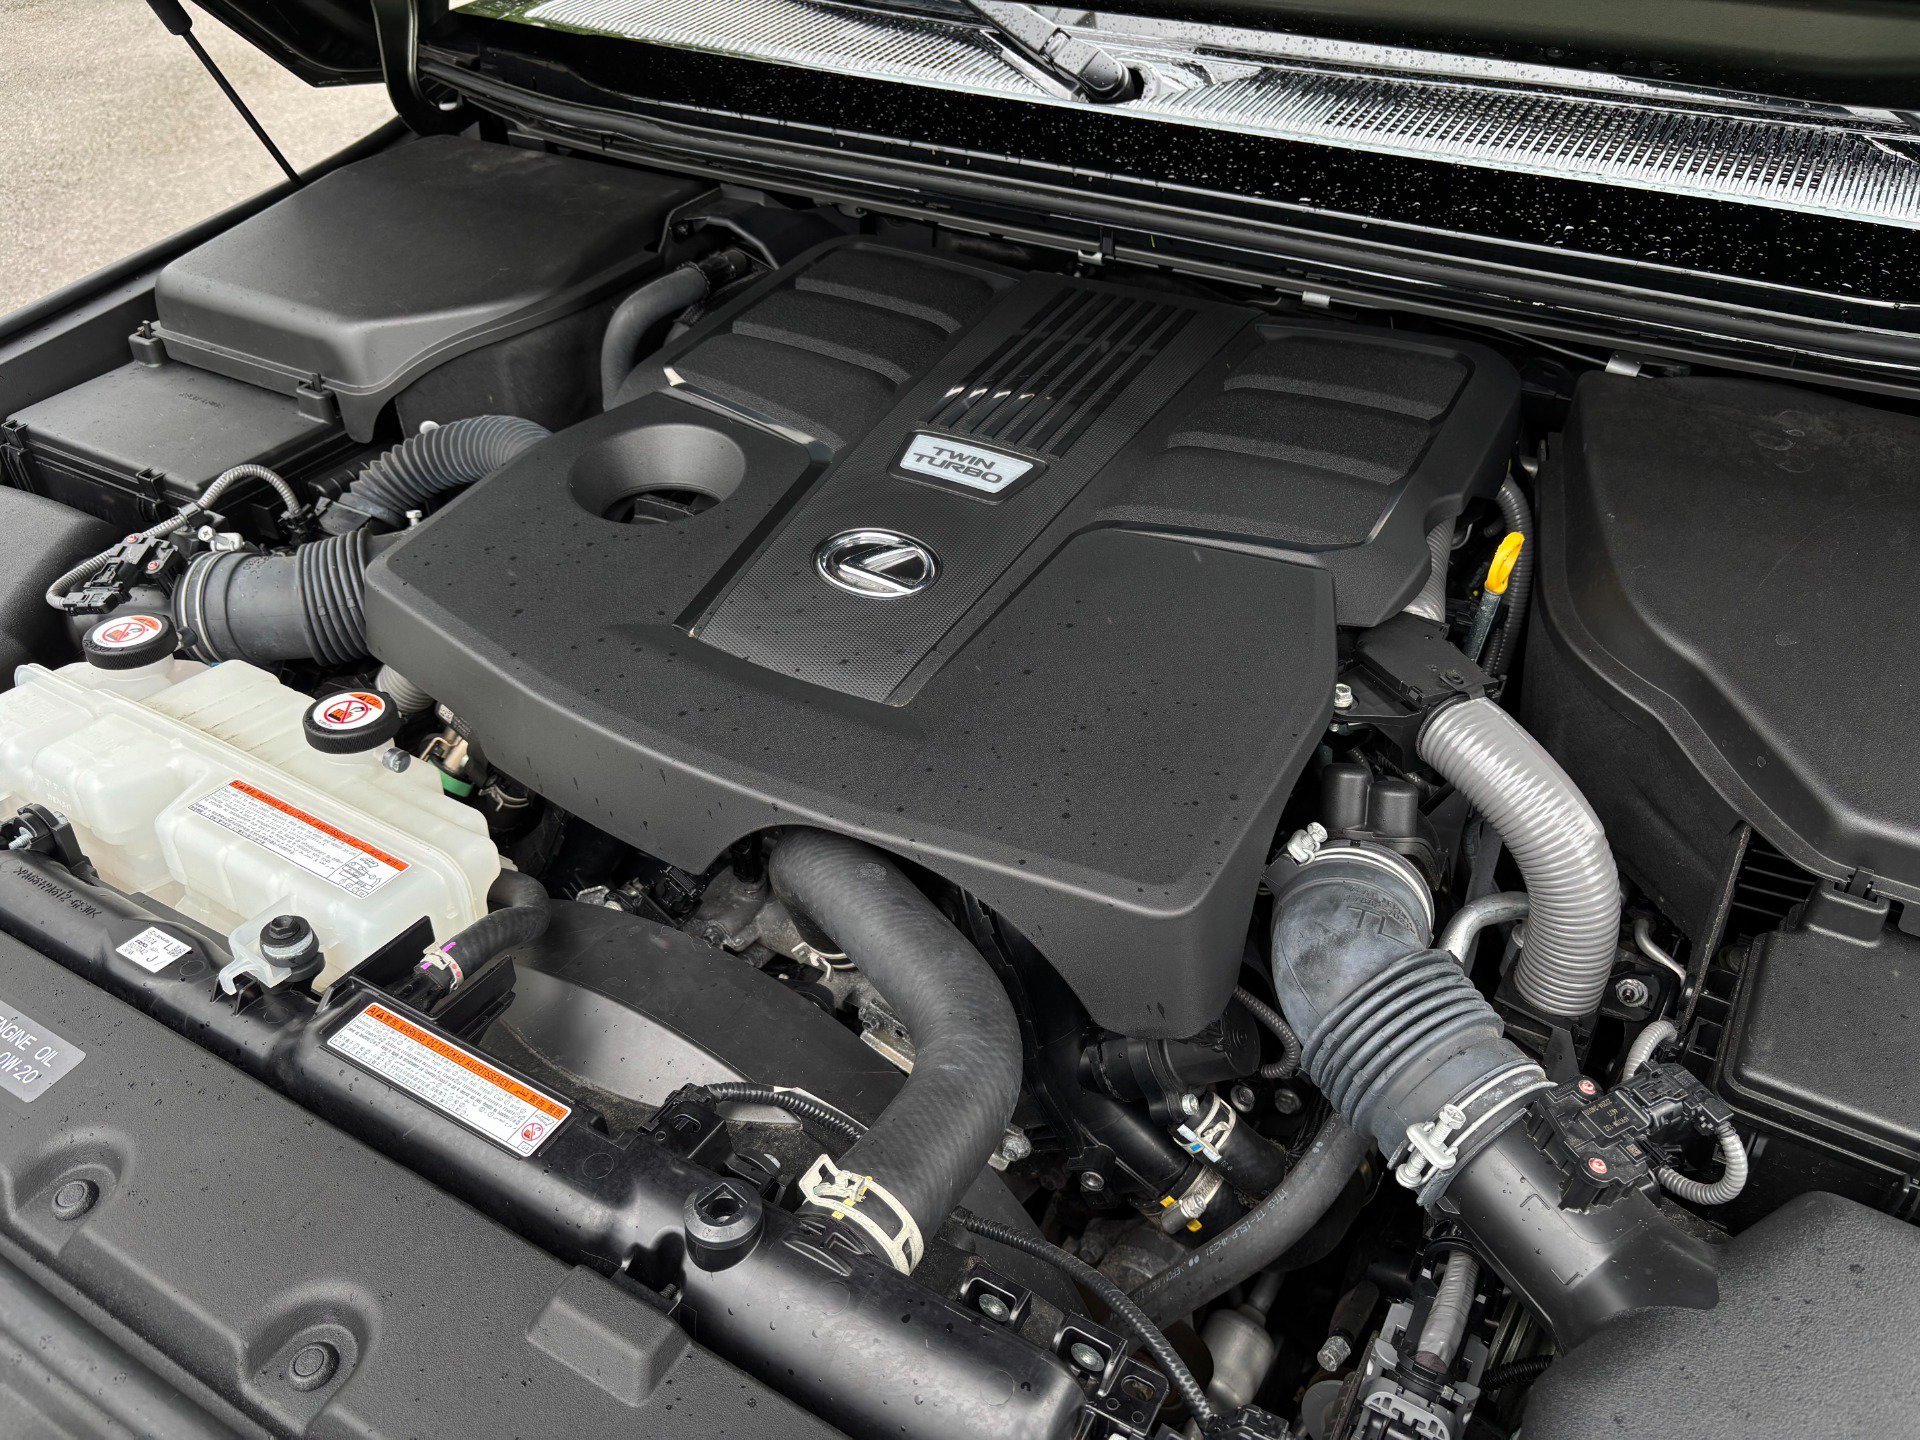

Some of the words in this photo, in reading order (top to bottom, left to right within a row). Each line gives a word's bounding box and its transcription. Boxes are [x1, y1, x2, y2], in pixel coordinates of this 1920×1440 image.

[912, 452, 1002, 484] TURBO
[932, 446, 995, 470] TWIN
[367, 1006, 377, 1014] A
[0, 1015, 38, 1051] NGINE
[34, 1046, 59, 1068] OIL
[398, 1023, 427, 1041] WARNING
[464, 1059, 514, 1089] AVERTISSEMENT
